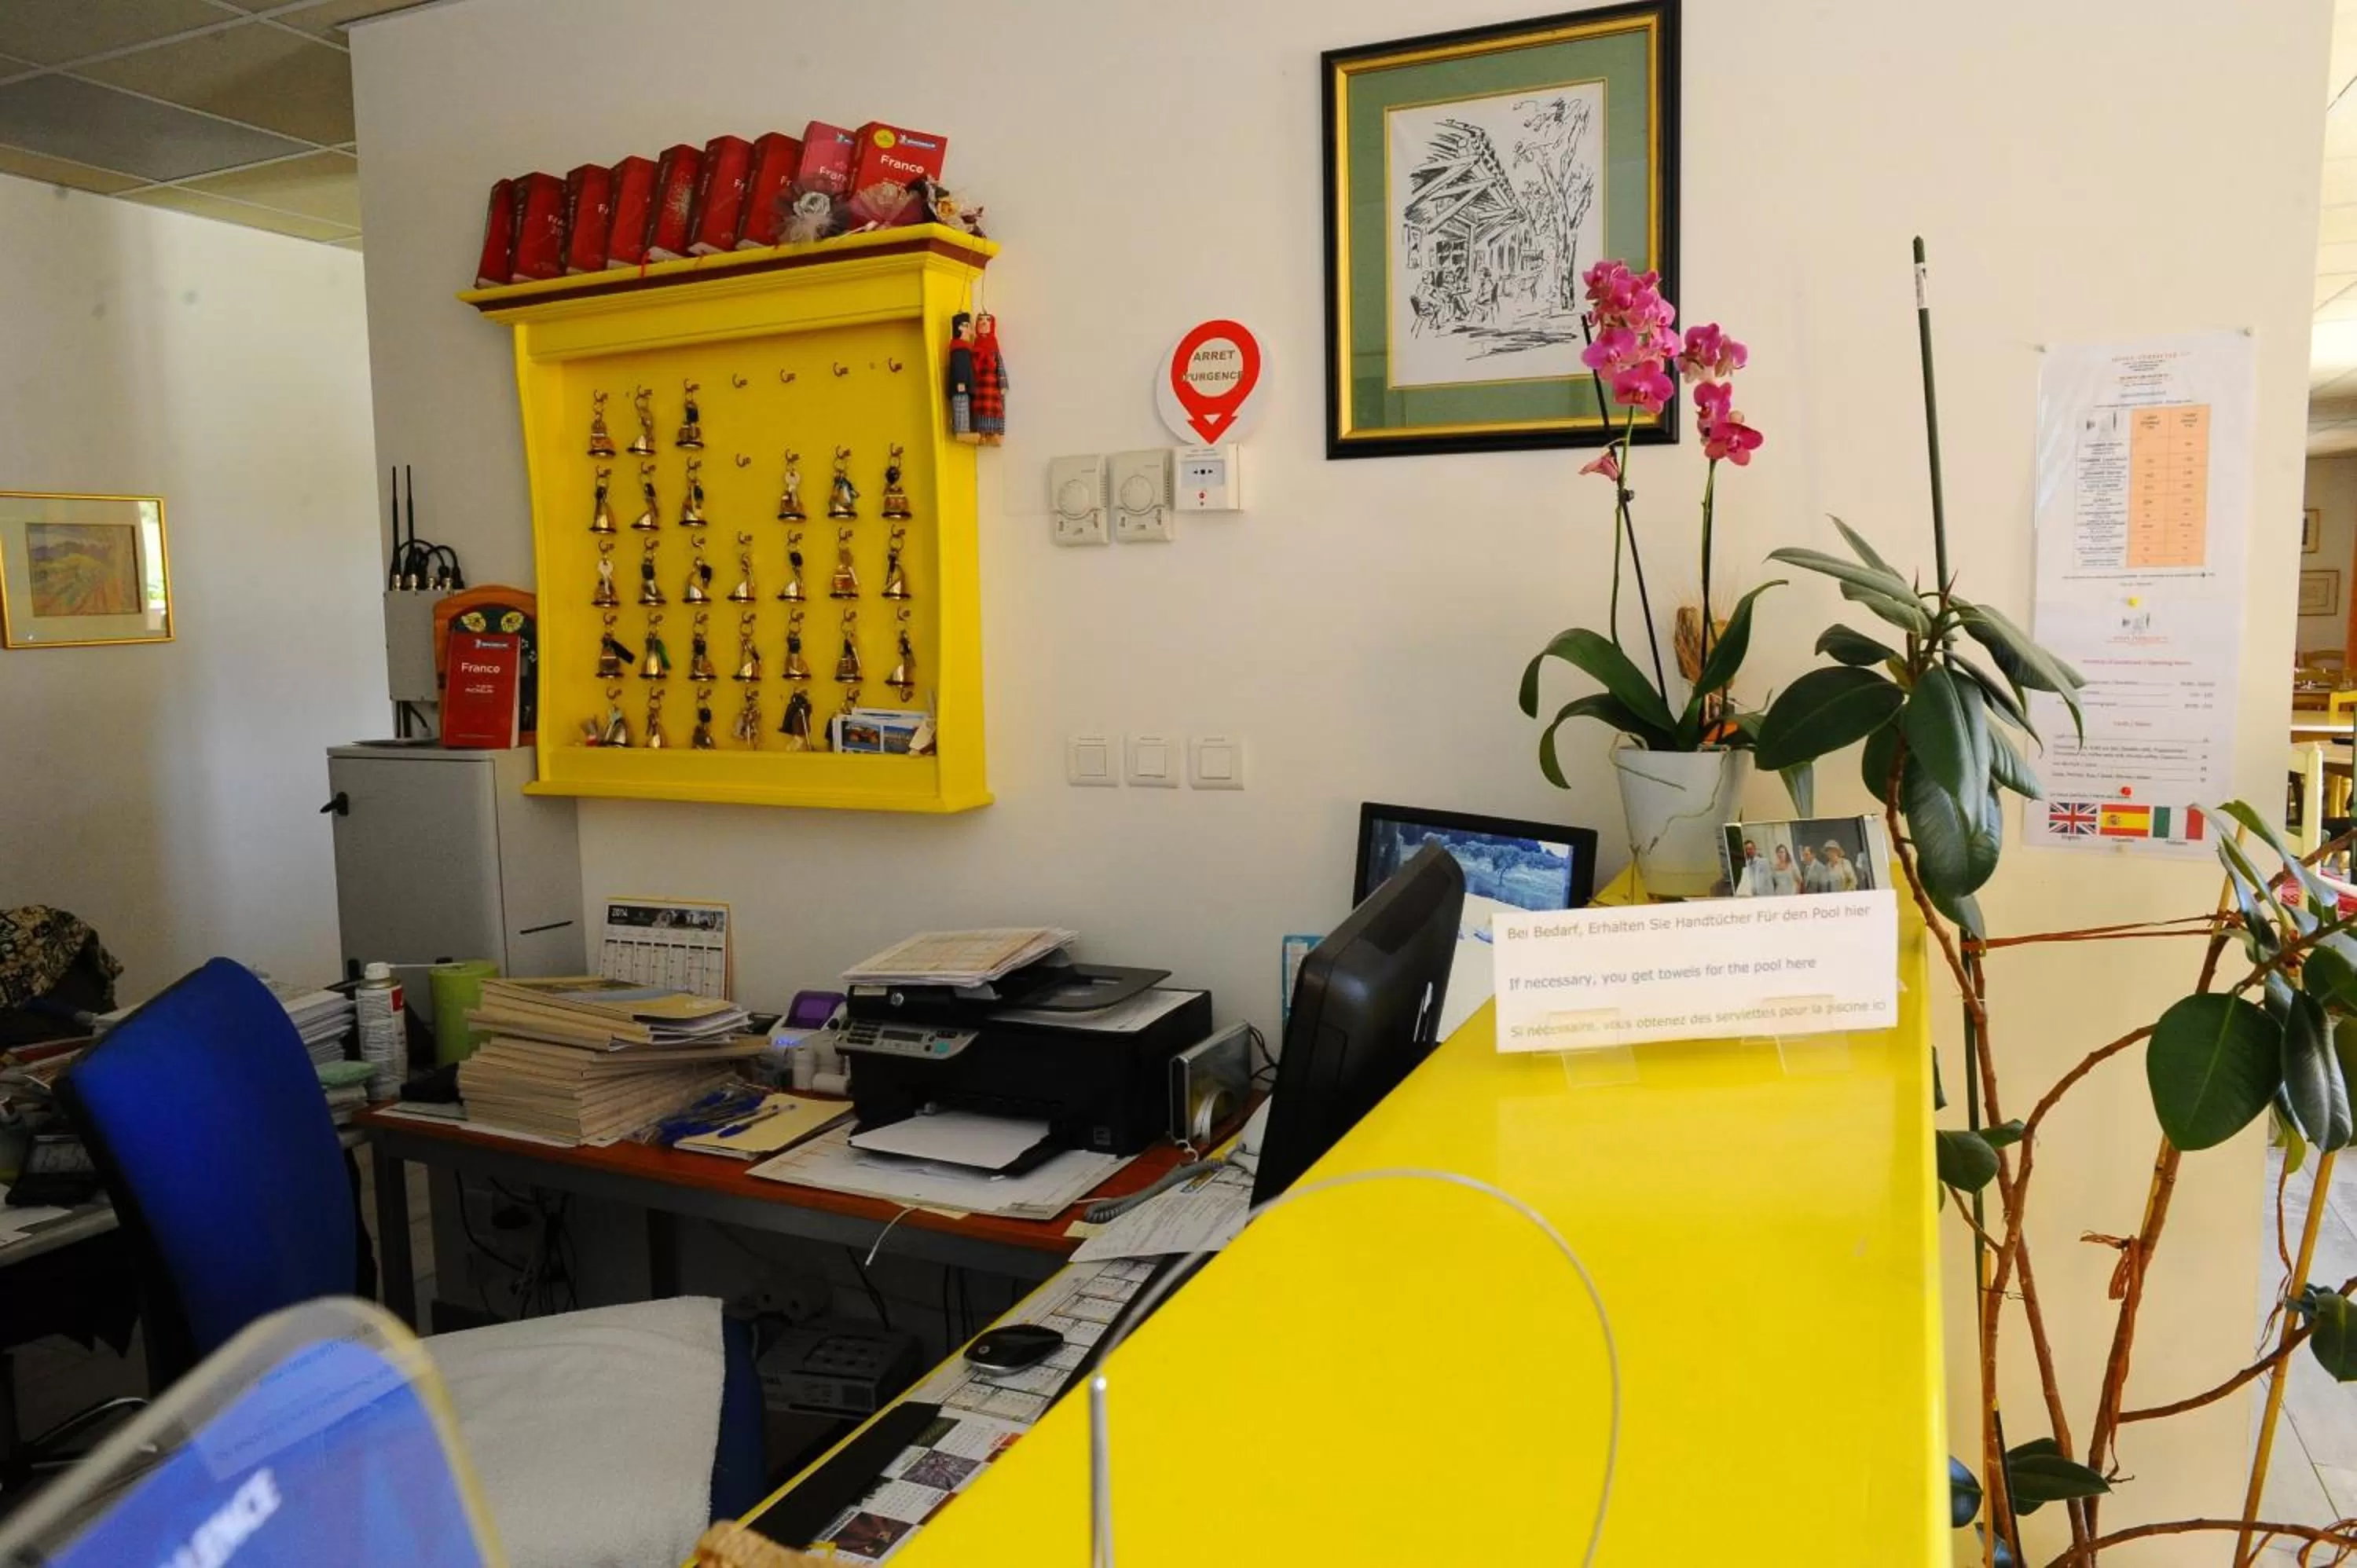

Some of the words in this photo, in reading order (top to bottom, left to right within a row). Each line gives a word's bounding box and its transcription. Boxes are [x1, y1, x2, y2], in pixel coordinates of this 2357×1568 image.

[880, 155, 925, 174] France
[1193, 350, 1235, 361] ARRET
[461, 662, 500, 673] France
[1508, 927, 1528, 940] Bei
[1534, 923, 1584, 938] Bedarf,
[1588, 919, 1645, 935] Erhalten
[1649, 918, 1671, 931] Sie
[1757, 909, 1780, 923] Für
[1783, 909, 1808, 921] den
[1813, 905, 1840, 918] Pool
[1845, 903, 1871, 916] hier
[1509, 977, 1521, 991] If
[1524, 975, 1596, 989] necessary,
[1602, 973, 1626, 985] you
[1632, 969, 1653, 984] get
[1659, 965, 1701, 979] towels
[1705, 964, 1724, 976] for
[1728, 962, 1750, 974] the
[1754, 958, 1782, 975] pool
[1786, 957, 1816, 969] here
[1510, 1025, 1523, 1038] Si
[1636, 1014, 1685, 1028] obtenez
[1690, 1012, 1711, 1025] des
[1716, 1007, 1776, 1023] serviettes
[1779, 1006, 1807, 1019] pour
[1811, 1001, 1824, 1013] la
